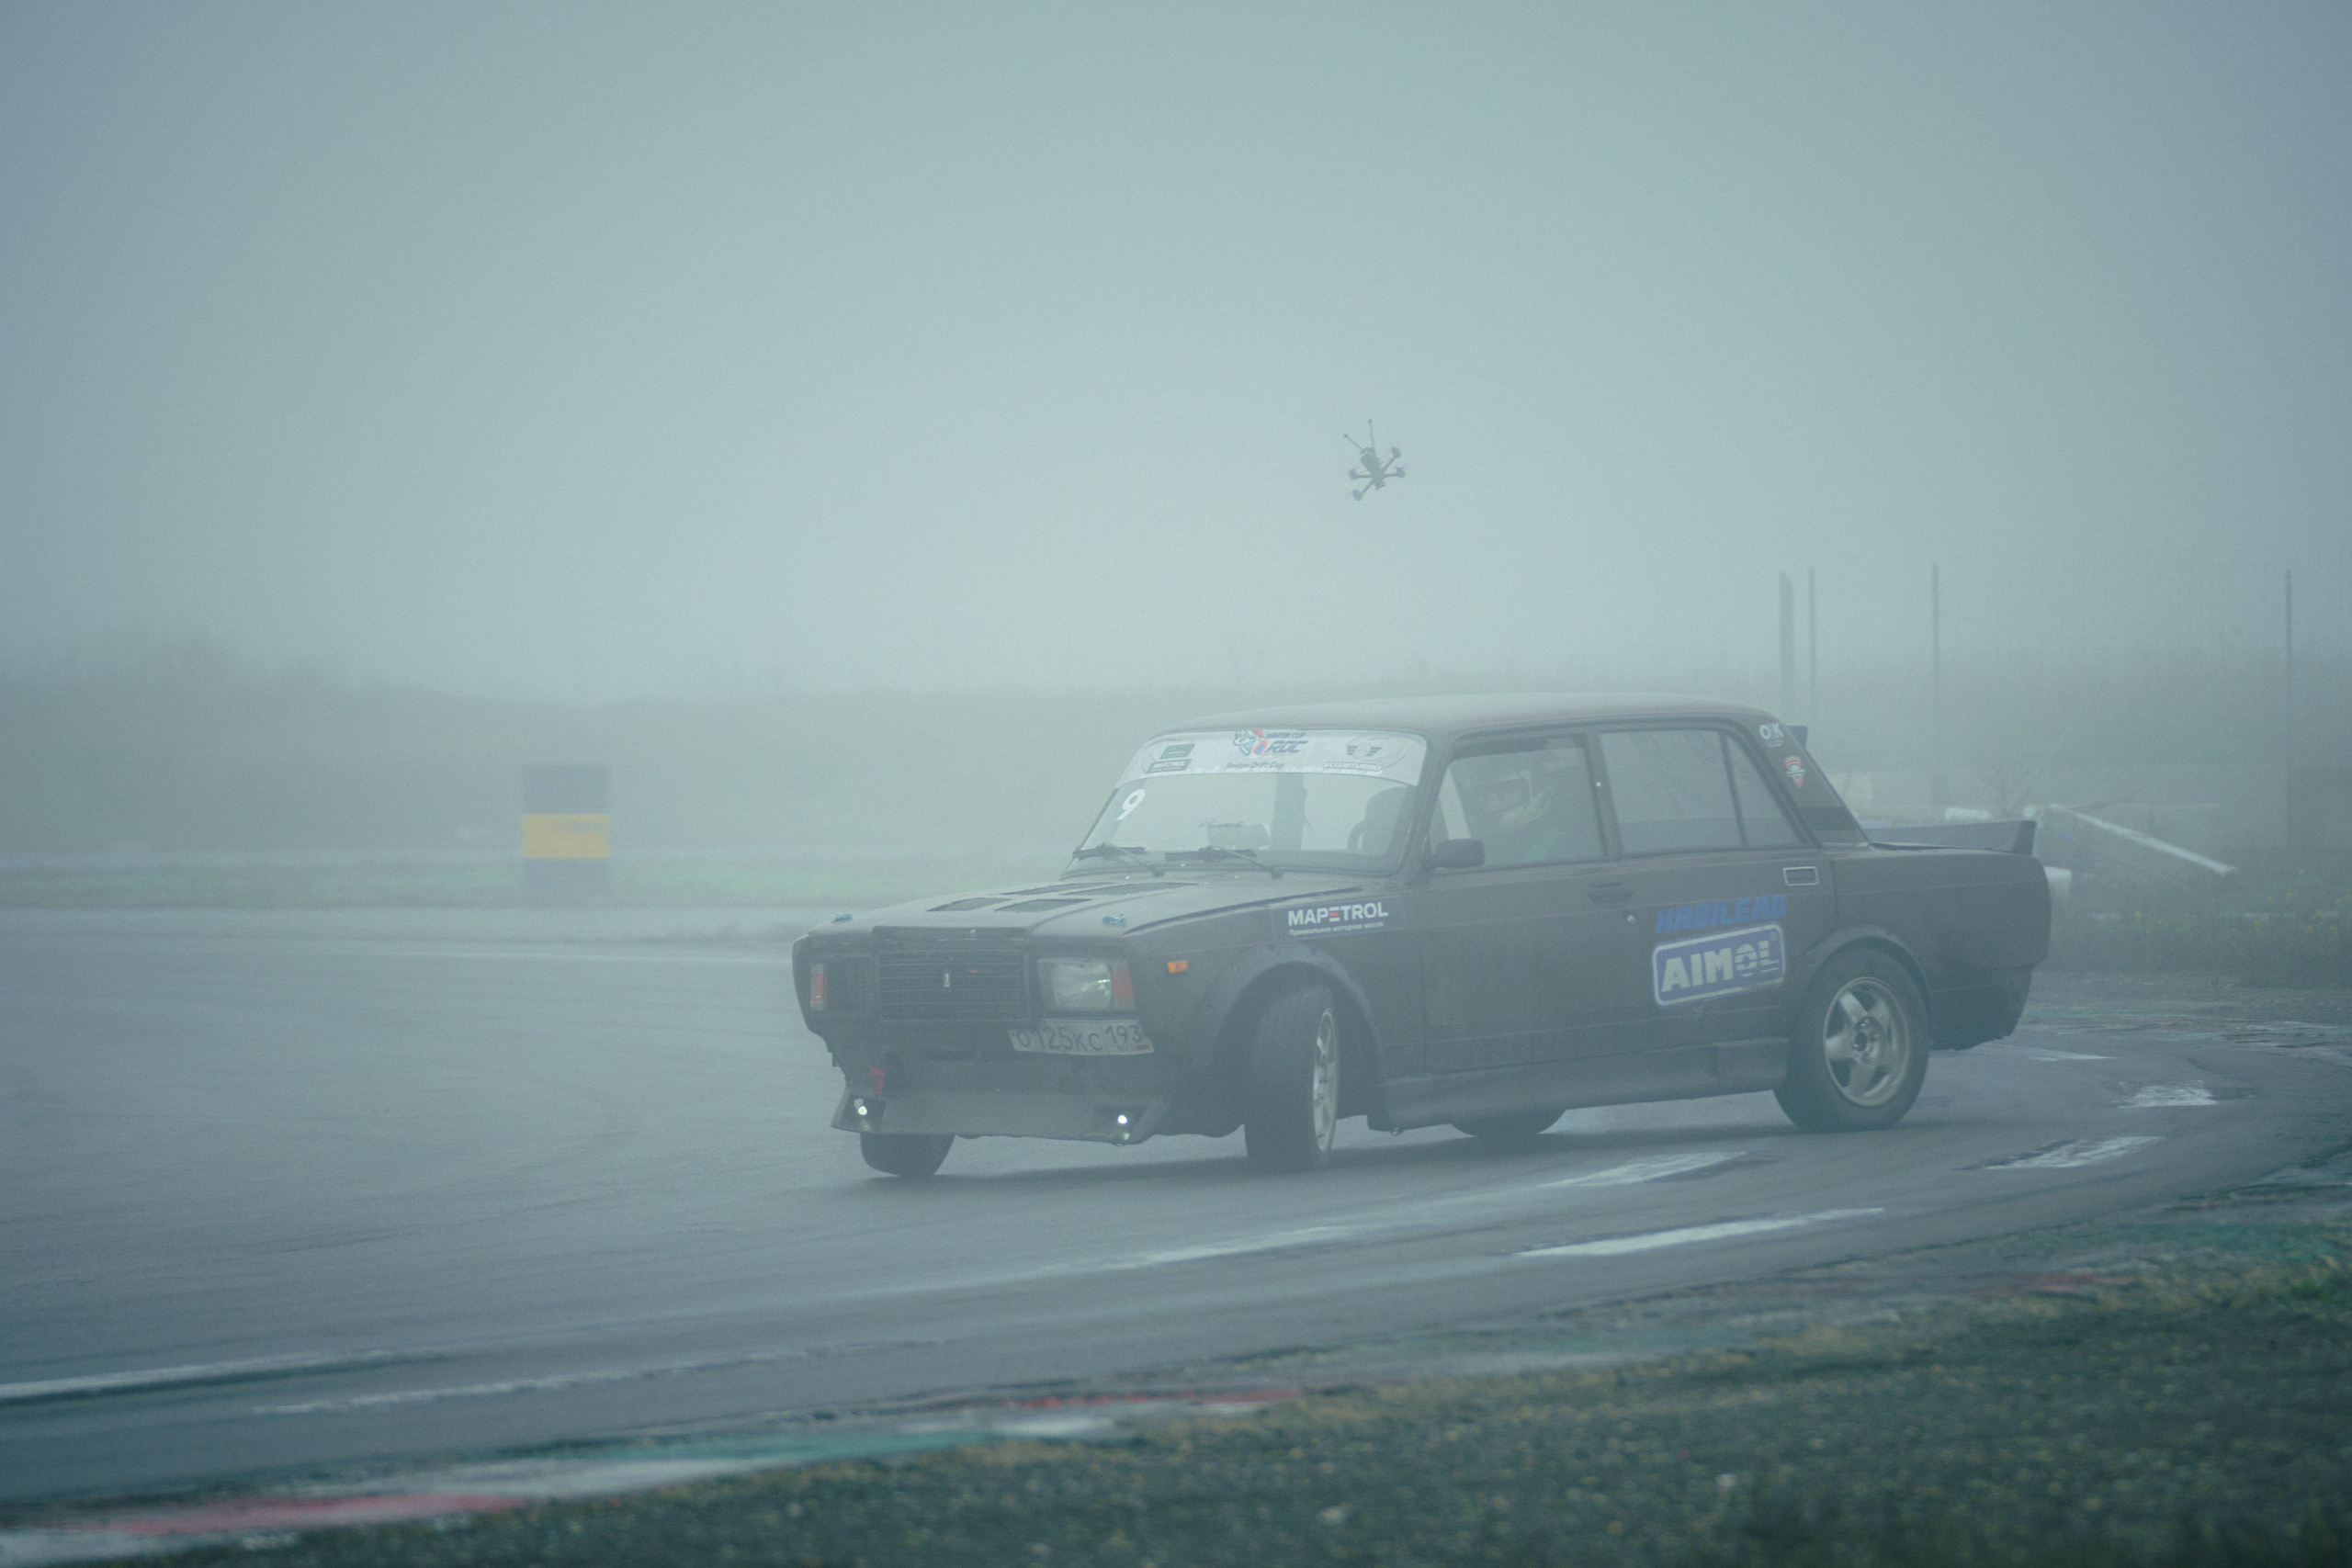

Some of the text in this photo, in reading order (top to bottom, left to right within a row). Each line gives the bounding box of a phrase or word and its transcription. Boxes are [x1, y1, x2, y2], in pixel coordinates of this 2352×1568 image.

[1116, 788, 1146, 820] 9
[1287, 902, 1389, 927] MAPETROL
[1661, 941, 1780, 992] AIMOL
